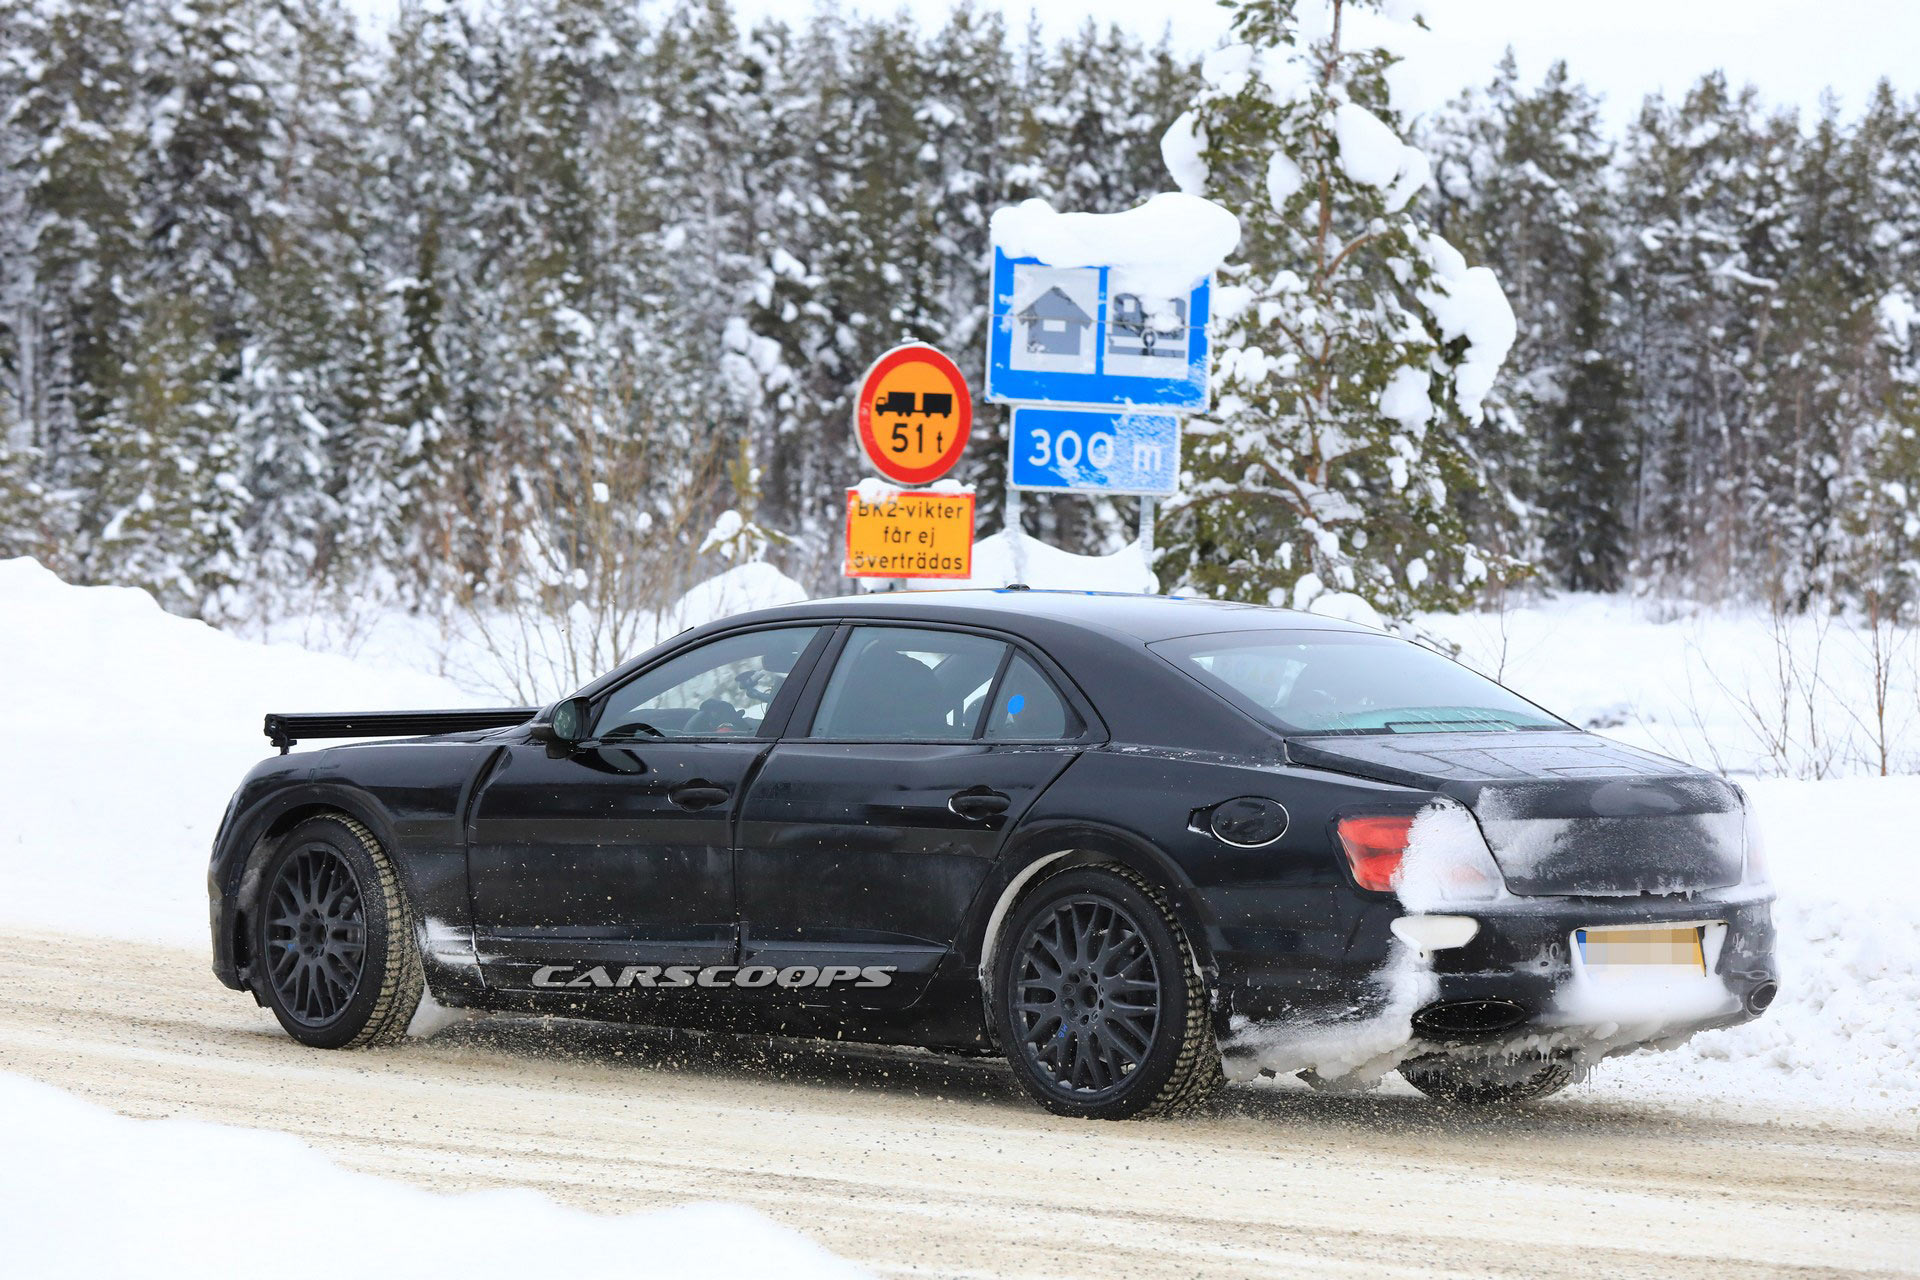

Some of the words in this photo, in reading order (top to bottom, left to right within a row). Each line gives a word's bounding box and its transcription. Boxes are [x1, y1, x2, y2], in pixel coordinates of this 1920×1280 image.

[892, 423, 923, 453] 51
[937, 431, 943, 454] t
[1028, 428, 1114, 469] 300
[1133, 443, 1162, 472] m
[884, 526, 911, 543] får
[918, 527, 935, 548] ej
[854, 551, 963, 570] överträdas
